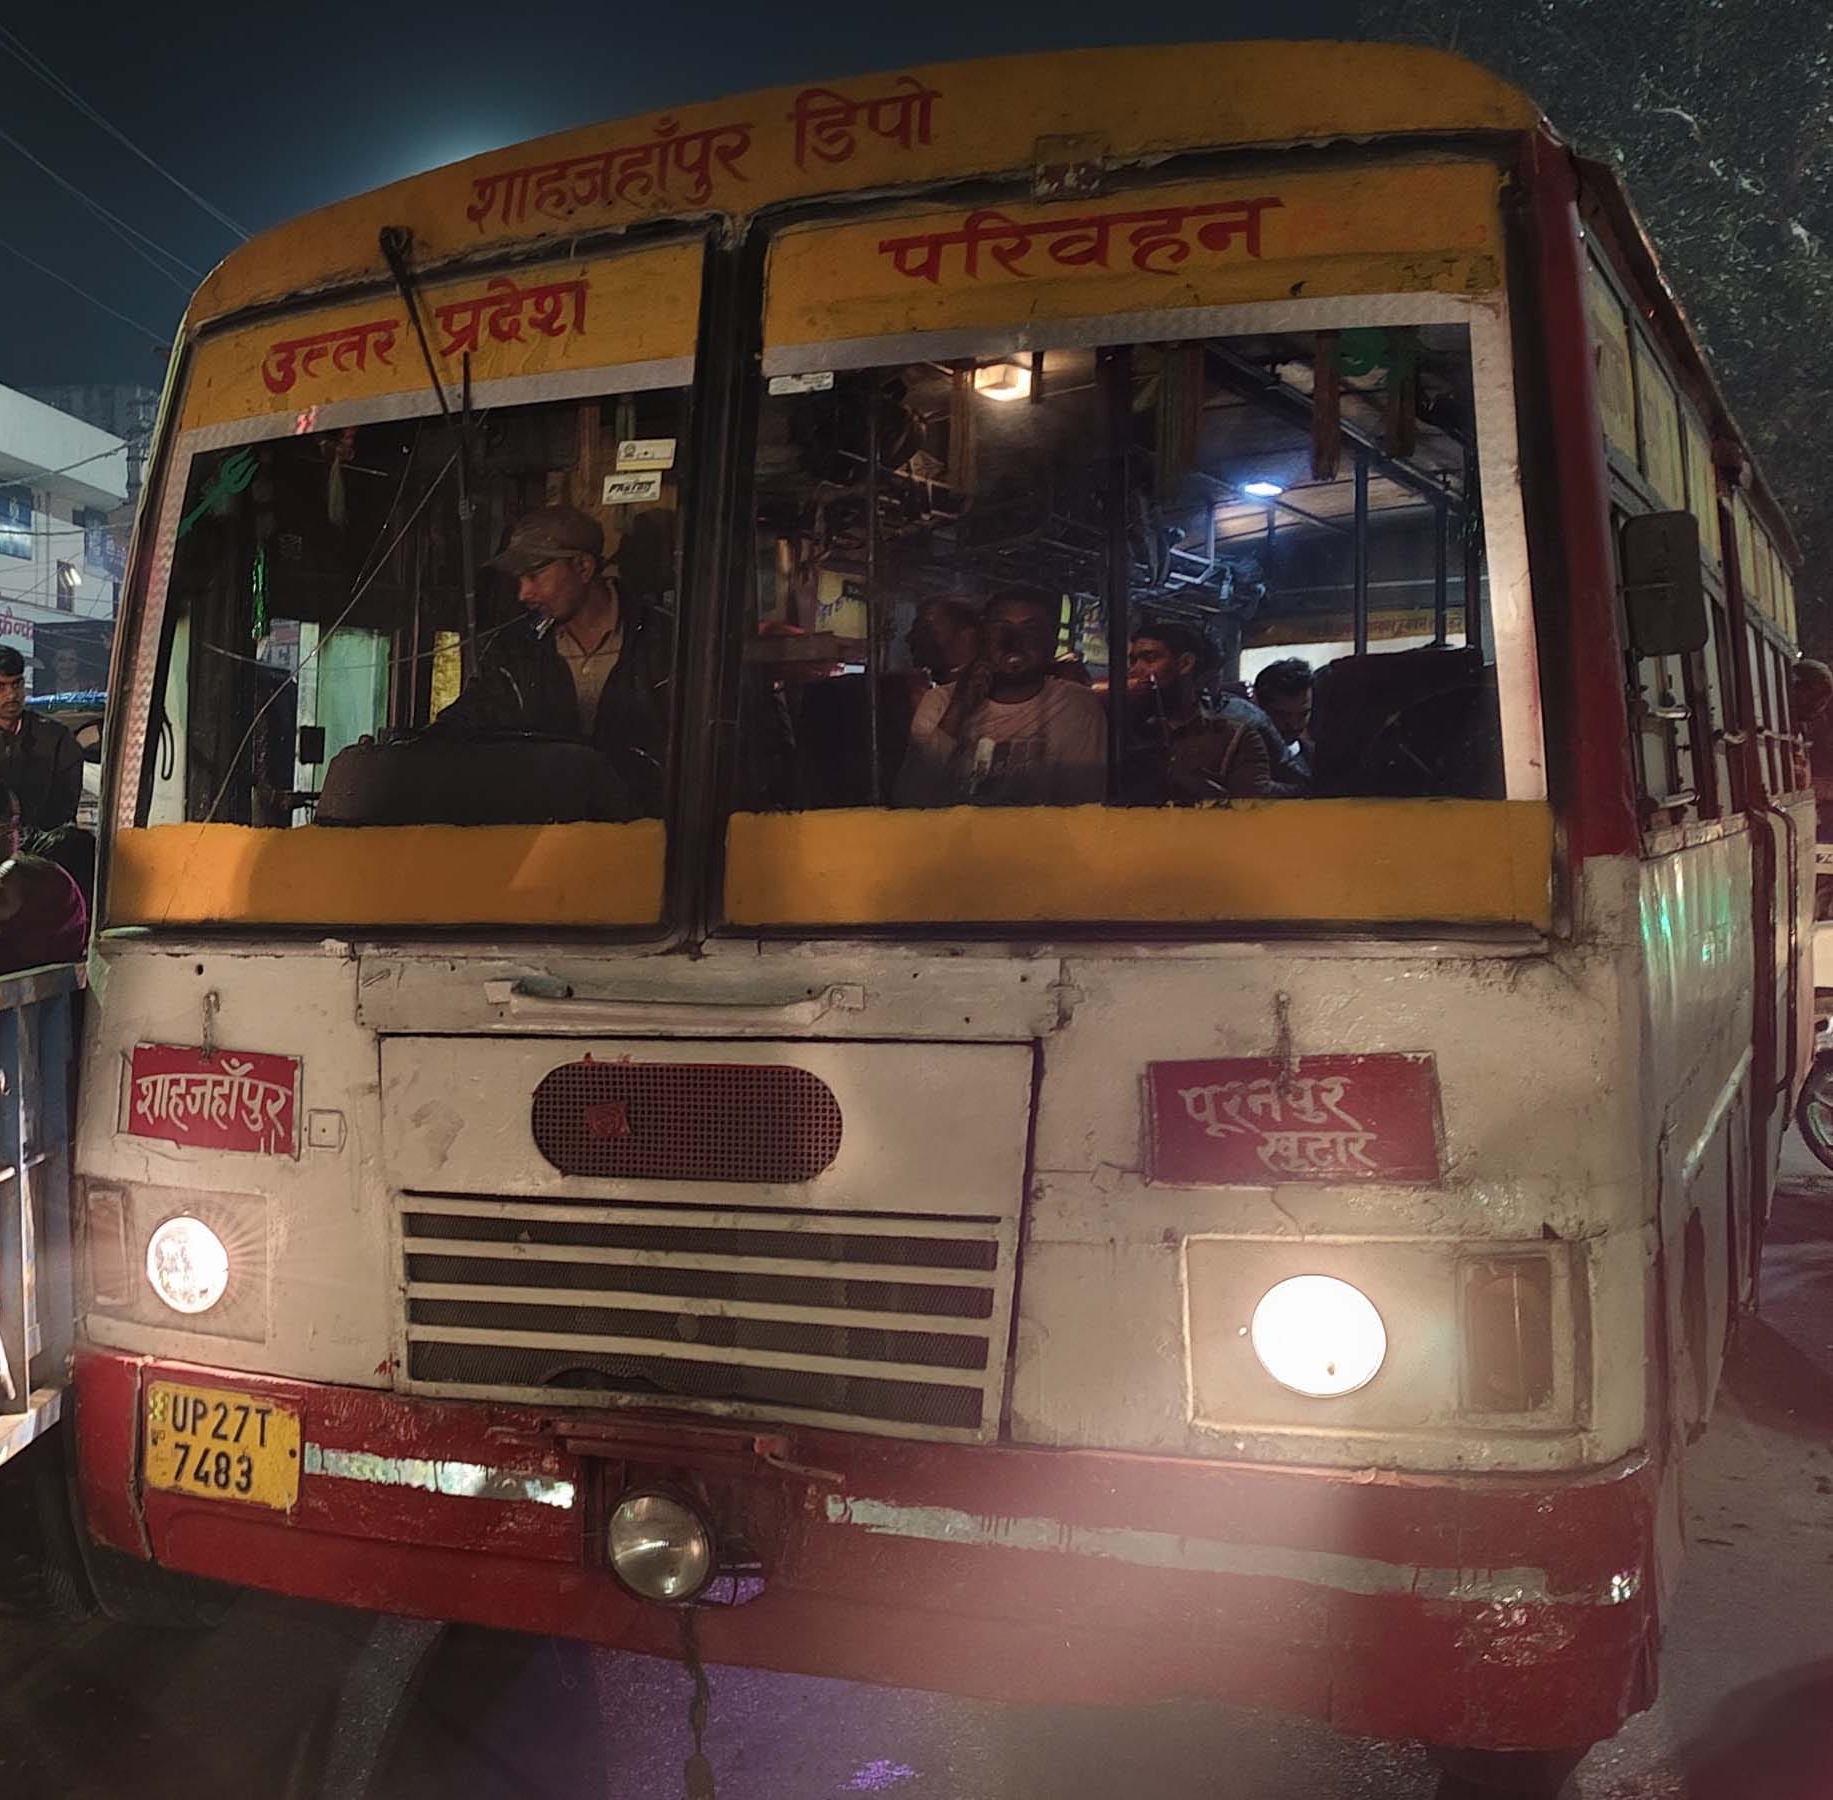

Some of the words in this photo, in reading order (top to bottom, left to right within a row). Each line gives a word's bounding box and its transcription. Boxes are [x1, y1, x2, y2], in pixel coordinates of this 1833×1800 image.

[465, 114, 757, 233] शाहजहाँपुर
[786, 77, 943, 172] डिपो
[879, 197, 1284, 284] परिवहन
[261, 319, 399, 394] उत्तर
[435, 277, 590, 359] प्रदेश
[136, 1057, 293, 1138] शाहजहाँपुर
[171, 1393, 273, 1448] UP27T
[174, 1441, 253, 1495] 7483
